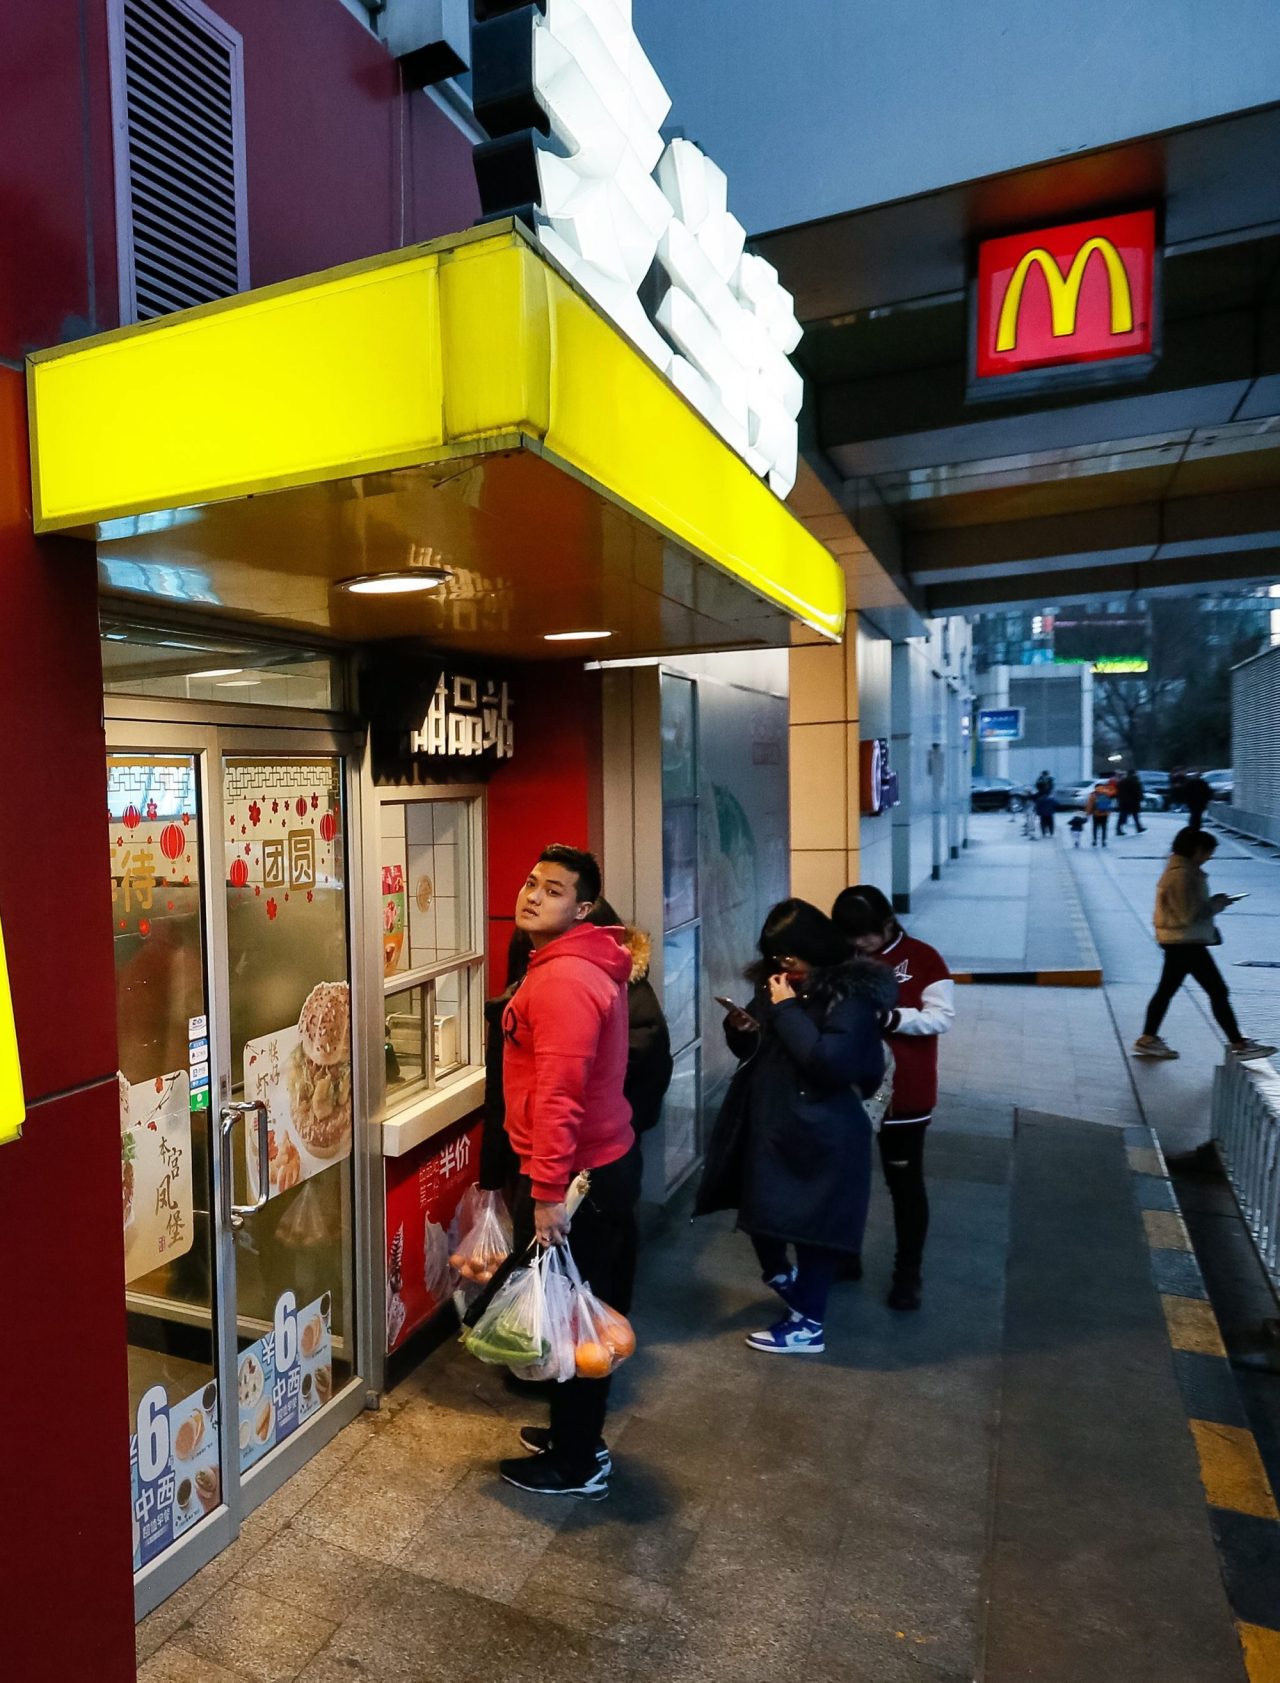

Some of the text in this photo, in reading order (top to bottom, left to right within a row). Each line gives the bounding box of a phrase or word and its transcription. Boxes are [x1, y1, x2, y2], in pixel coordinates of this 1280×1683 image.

[111, 848, 156, 913] 待
[262, 828, 315, 891] 团圆
[439, 1133, 471, 1179] 半价
[135, 1471, 175, 1523] 中西
